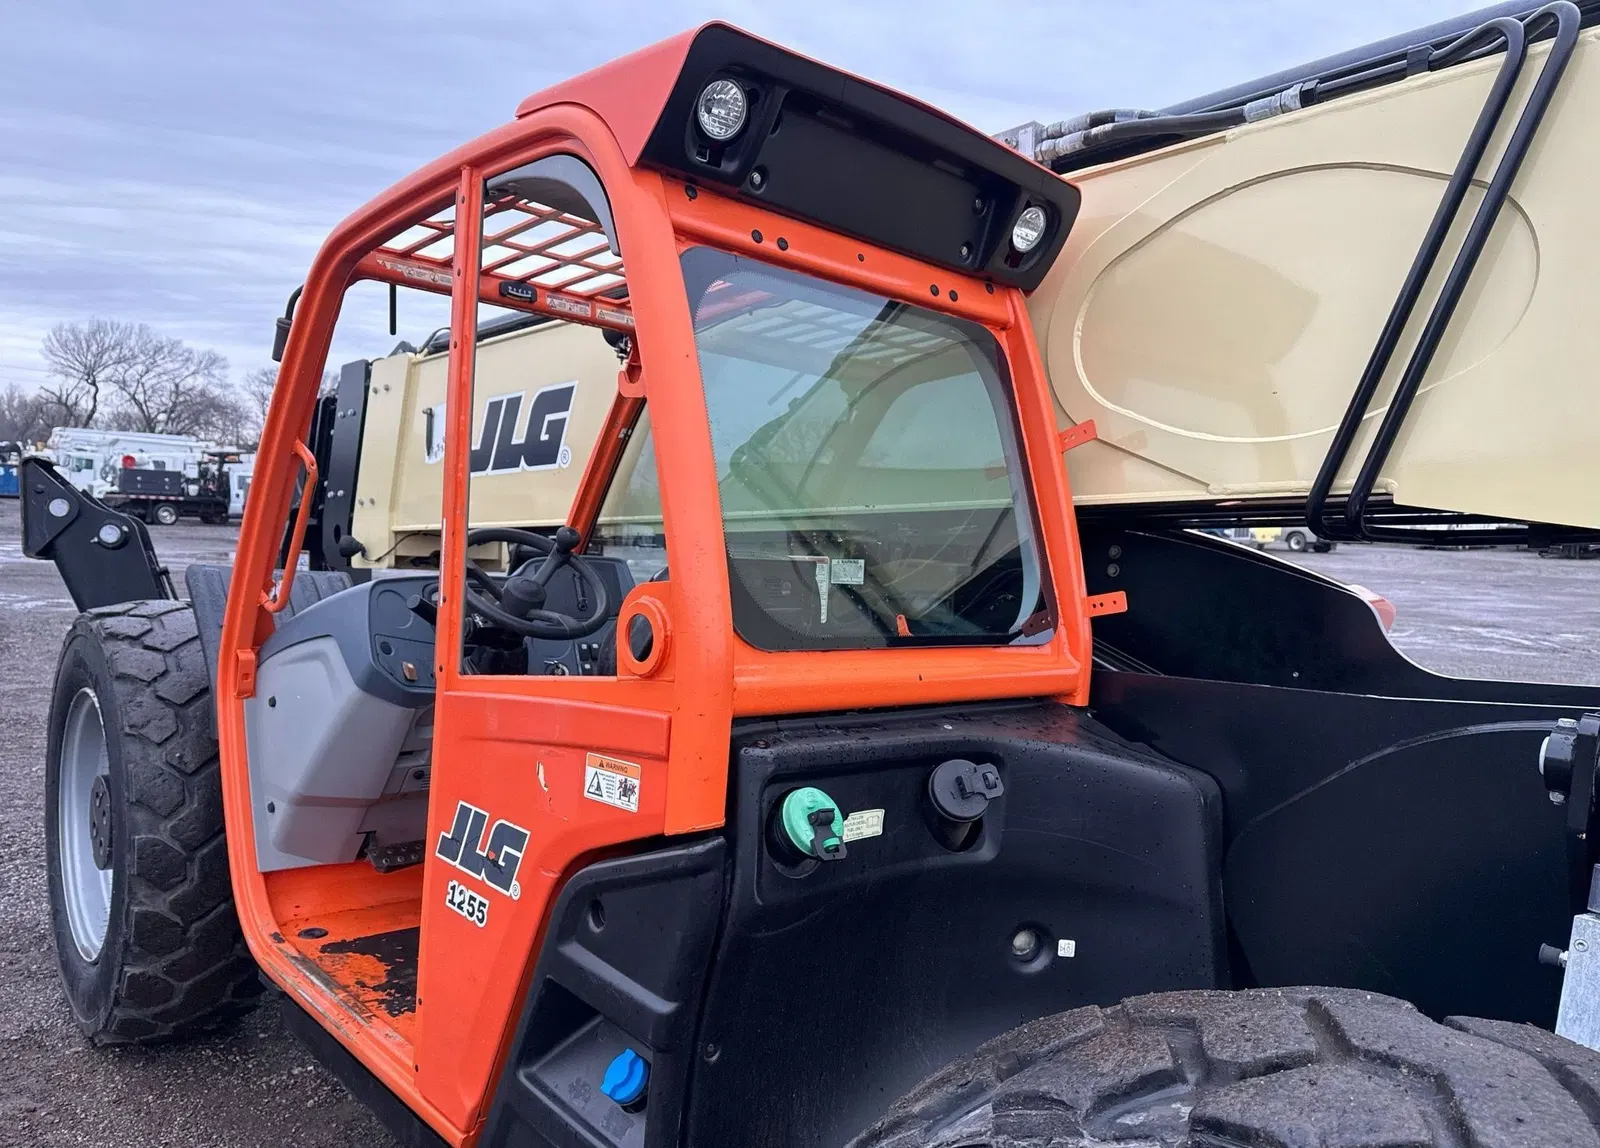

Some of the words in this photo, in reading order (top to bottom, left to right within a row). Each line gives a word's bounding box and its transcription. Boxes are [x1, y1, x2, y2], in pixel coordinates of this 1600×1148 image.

[470, 382, 577, 474] JLG
[605, 761, 628, 774] WARNING
[436, 801, 530, 896] JLG
[447, 883, 487, 925] 1255
